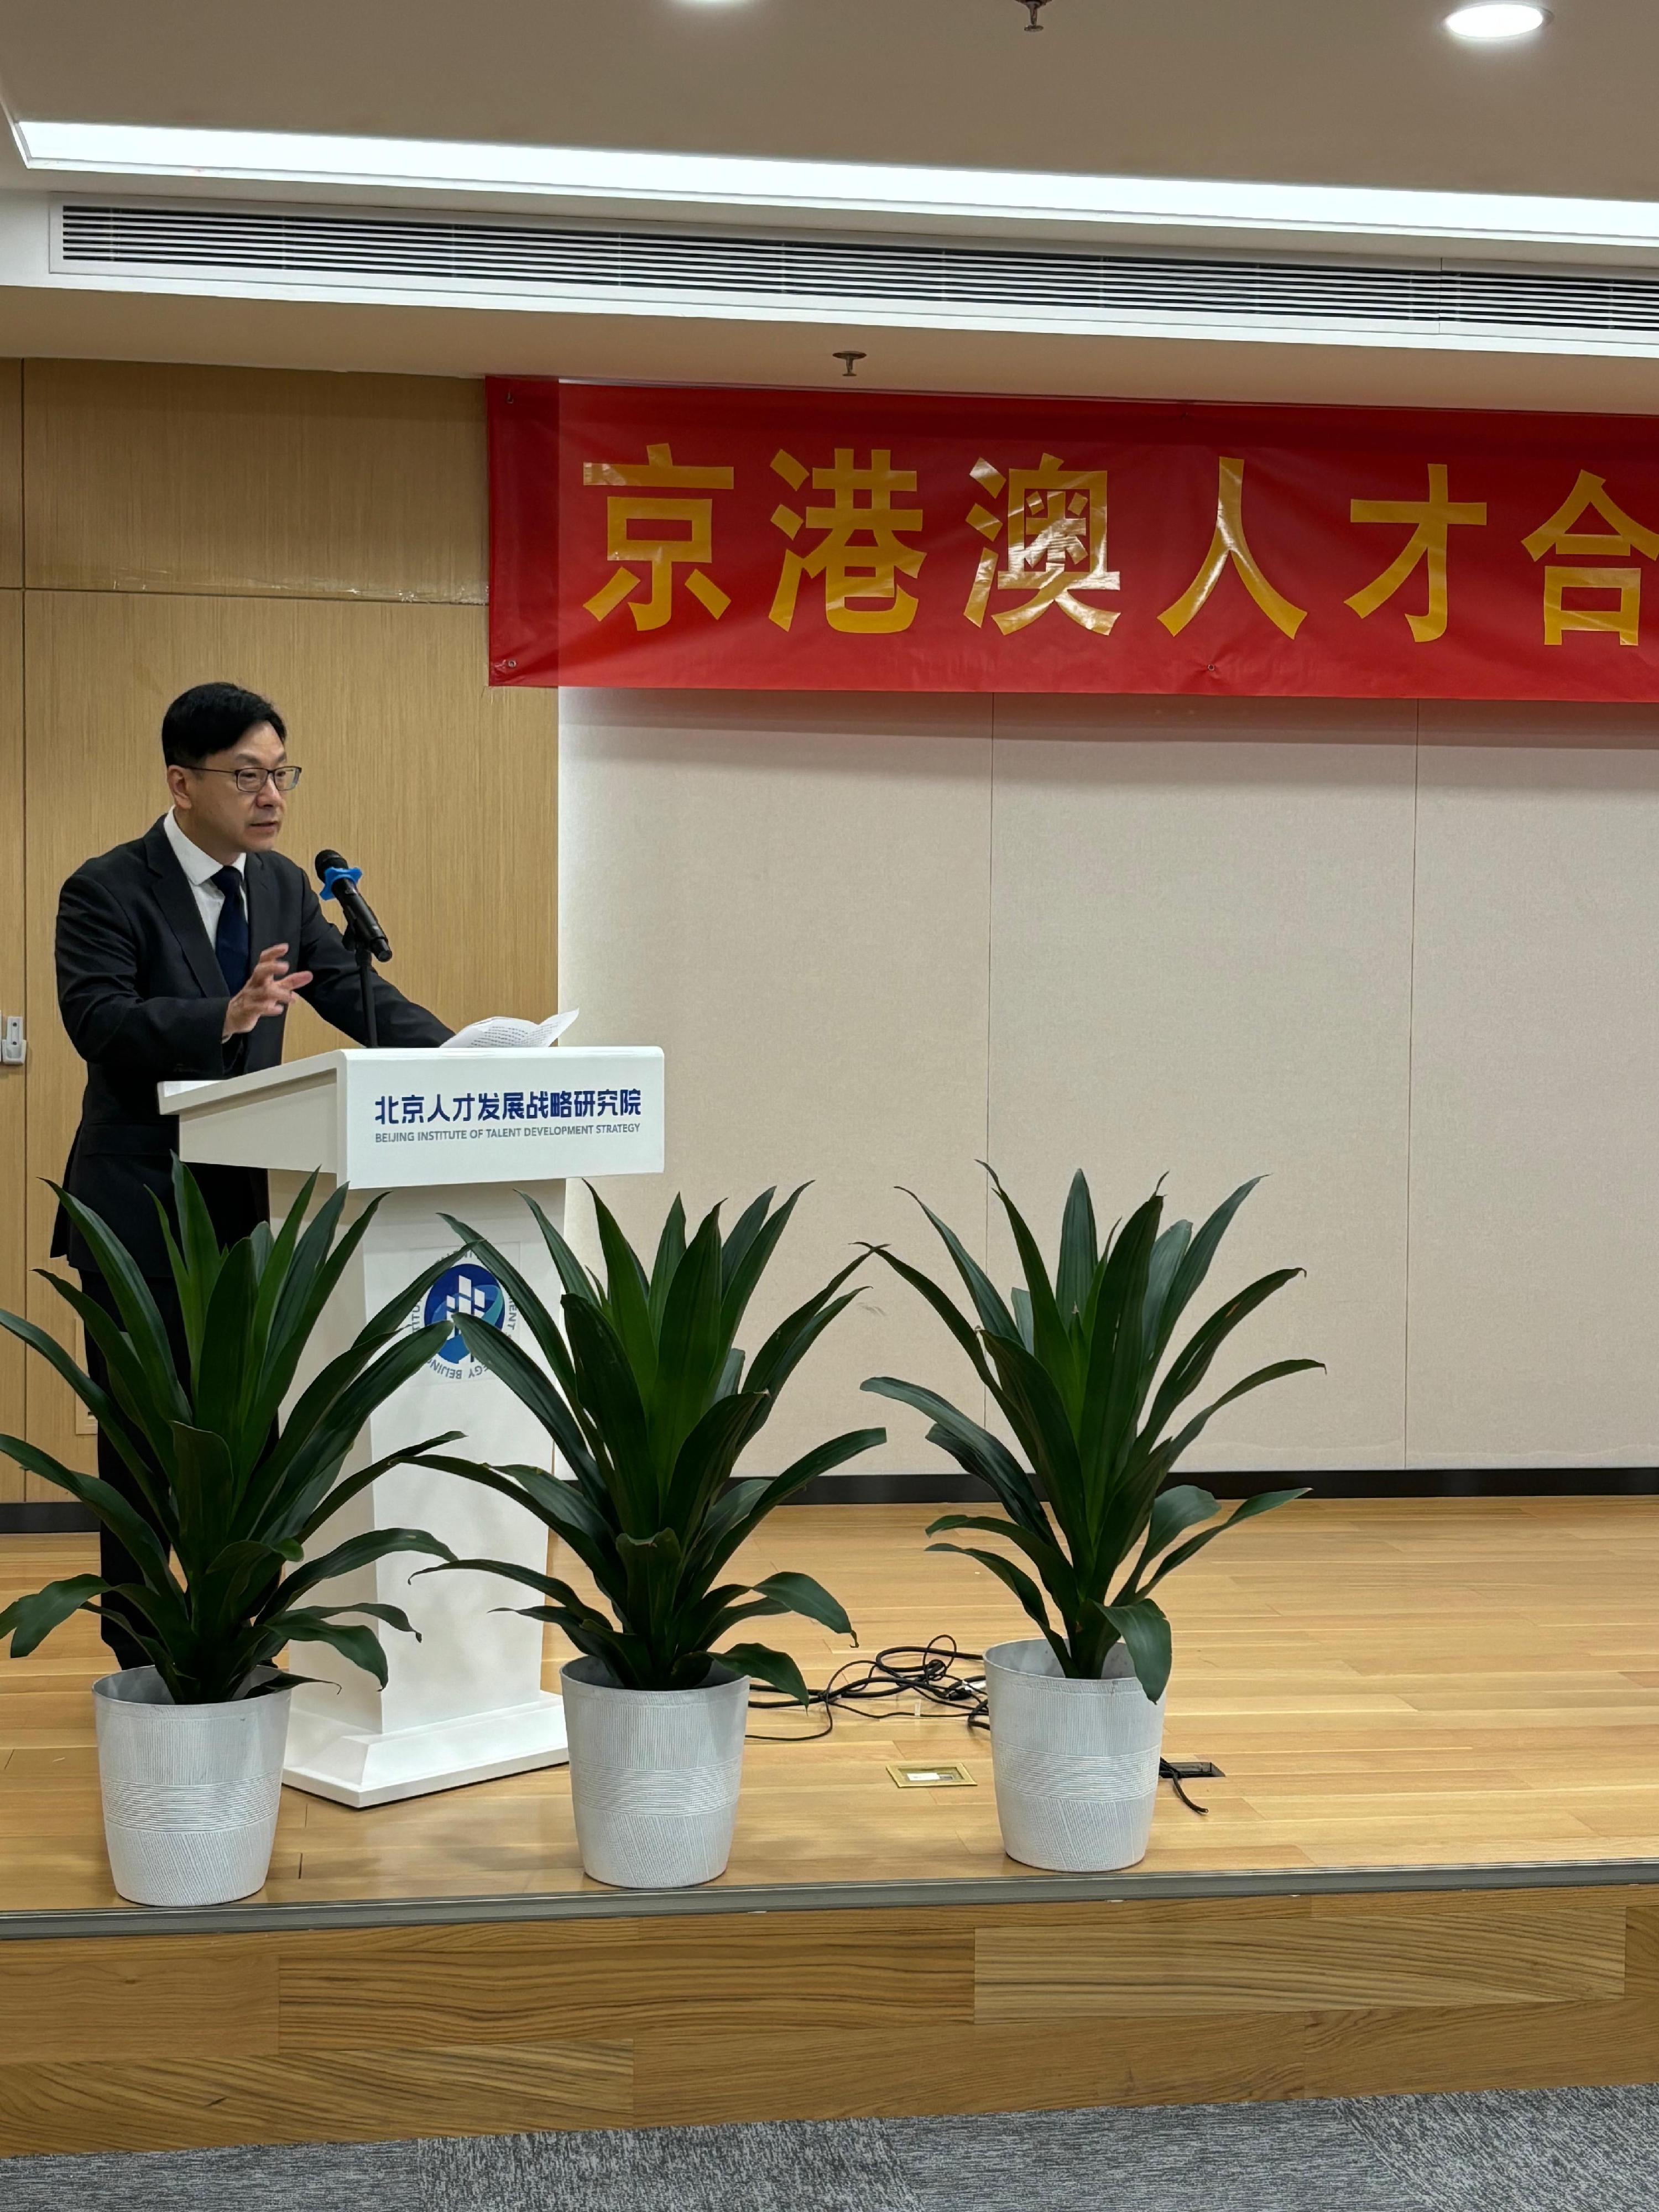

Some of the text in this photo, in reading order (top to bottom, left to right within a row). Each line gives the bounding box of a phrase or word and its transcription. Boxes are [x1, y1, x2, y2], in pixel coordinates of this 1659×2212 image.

[583, 443, 1659, 646] 京港澳人才合
[374, 1088, 641, 1125] 北京人才发展战略研究院
[375, 1123, 640, 1142] BEIJING INSTITUTE OF TALENT DEVELOPMENT STRATEGY
